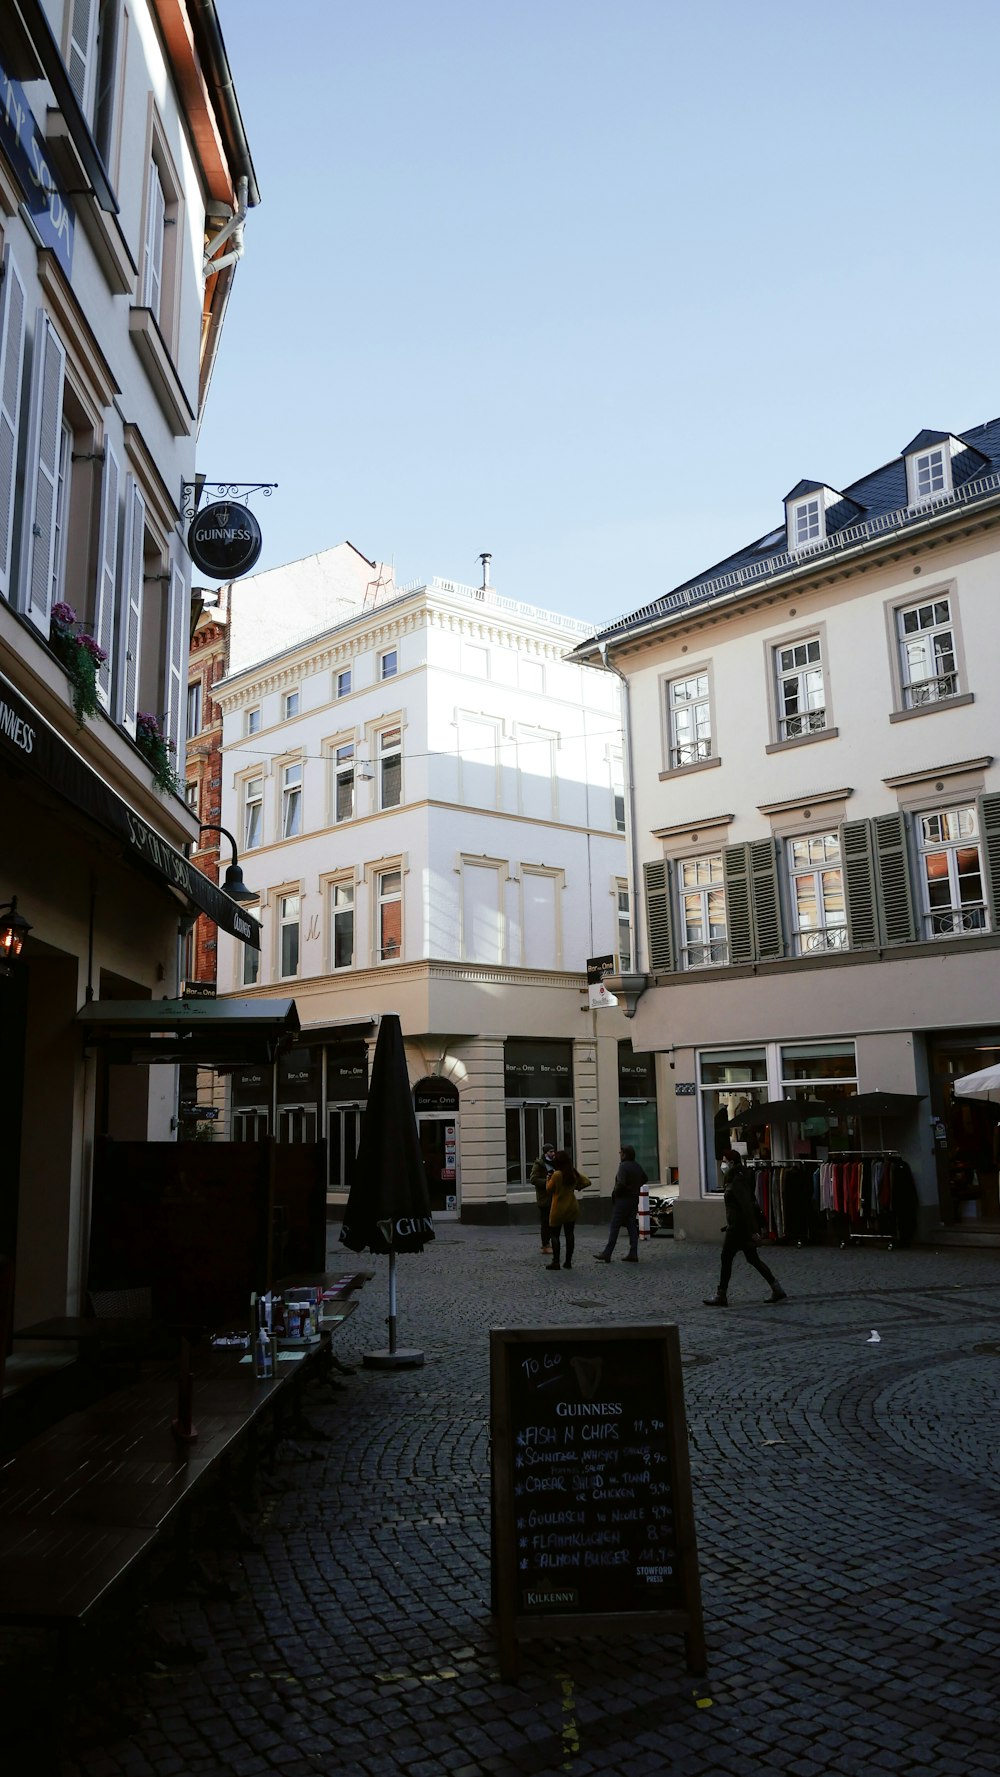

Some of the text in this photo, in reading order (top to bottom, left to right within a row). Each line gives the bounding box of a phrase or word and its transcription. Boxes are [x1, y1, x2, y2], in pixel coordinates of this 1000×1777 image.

[195, 528, 251, 542] GUINNESS
[186, 987, 216, 997] Bar One
[540, 1064, 551, 1072] Bar
[417, 1096, 456, 1104] Bar One
[522, 1353, 562, 1378] TO GO
[556, 1402, 623, 1416] GUINNESS
[525, 1426, 556, 1445] FISH
[581, 1423, 620, 1440] CHIPS
[524, 1475, 568, 1493] CAESAR
[621, 1470, 651, 1484] TUNA
[592, 1488, 636, 1500] CHICKEN
[534, 1552, 581, 1569] SALMON
[584, 1549, 631, 1568] BURGER
[636, 1566, 673, 1575] STOWFORD
[646, 1575, 664, 1583] PRESS
[527, 1592, 575, 1605] KILKENNY
